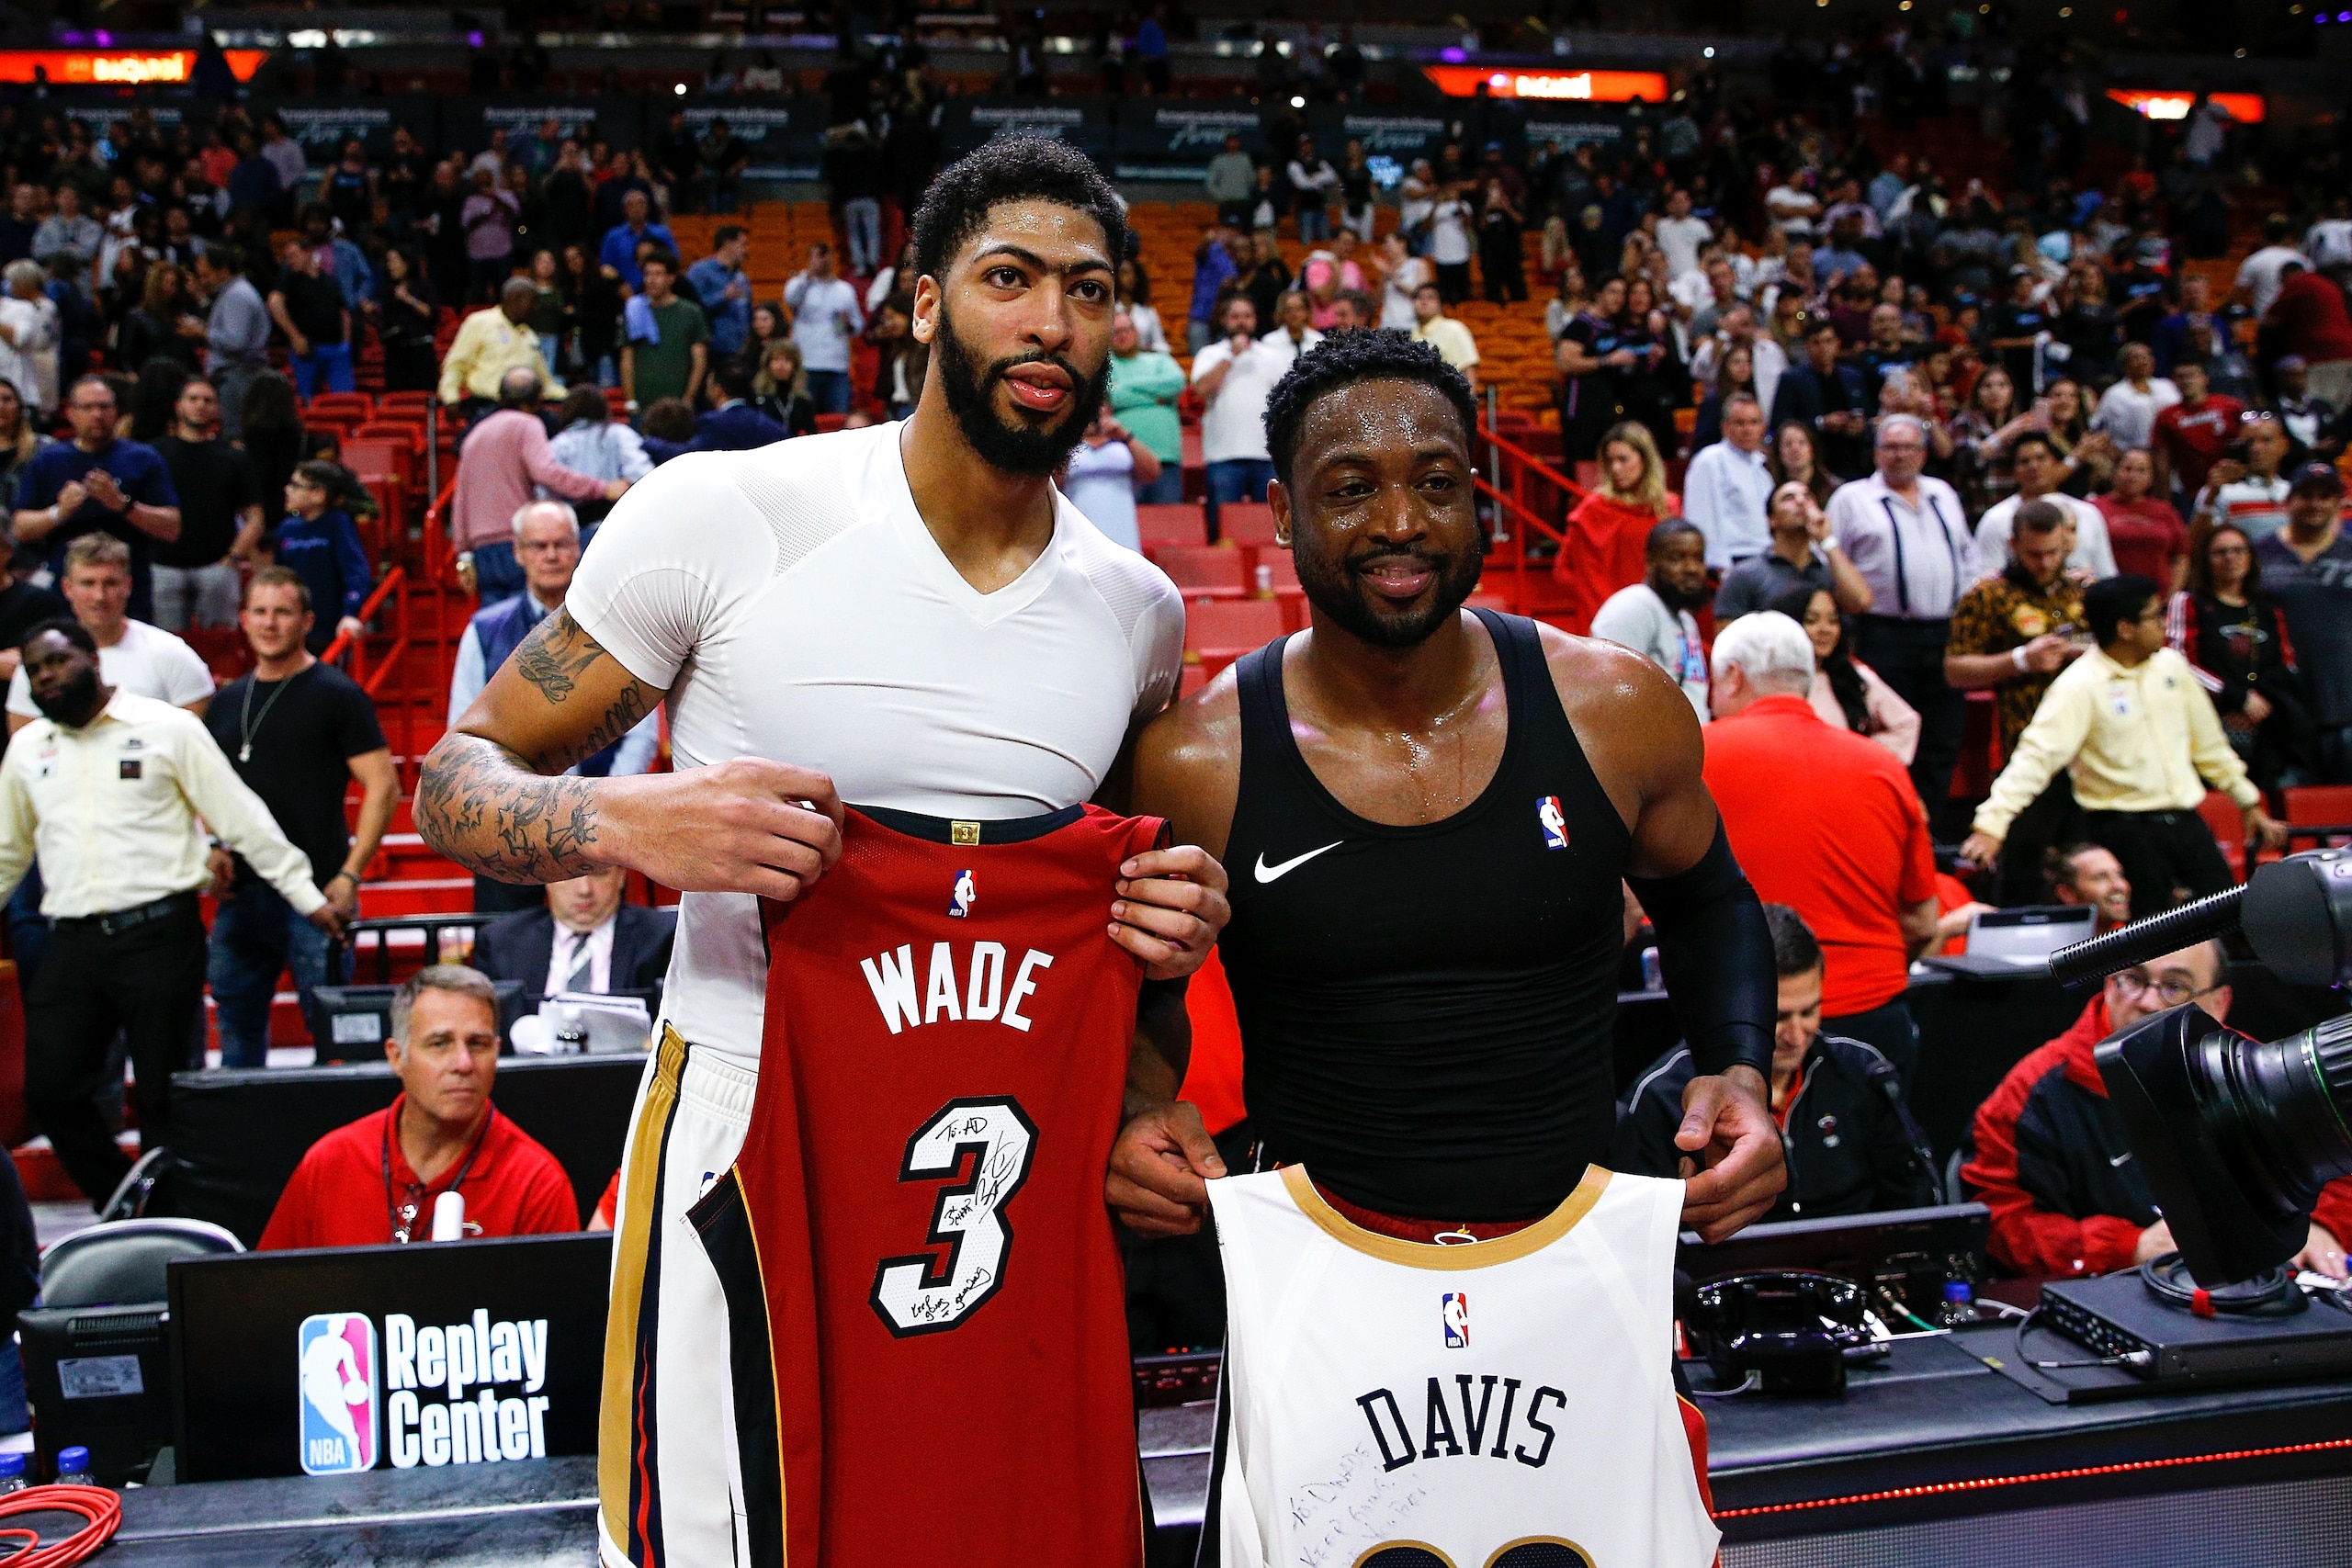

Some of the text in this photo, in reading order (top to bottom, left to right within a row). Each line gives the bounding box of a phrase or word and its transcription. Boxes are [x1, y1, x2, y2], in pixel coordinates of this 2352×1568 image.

[1547, 837, 1564, 848] NBA
[949, 908, 964, 917] NBA
[860, 941, 1055, 1035] WADE
[868, 1094, 1040, 1339] 3
[385, 1308, 548, 1400] Replay
[1447, 1337, 1462, 1348] NBA
[309, 1437, 346, 1466] NBA
[388, 1388, 549, 1469] Center
[1355, 1374, 1567, 1473] DAVIS
